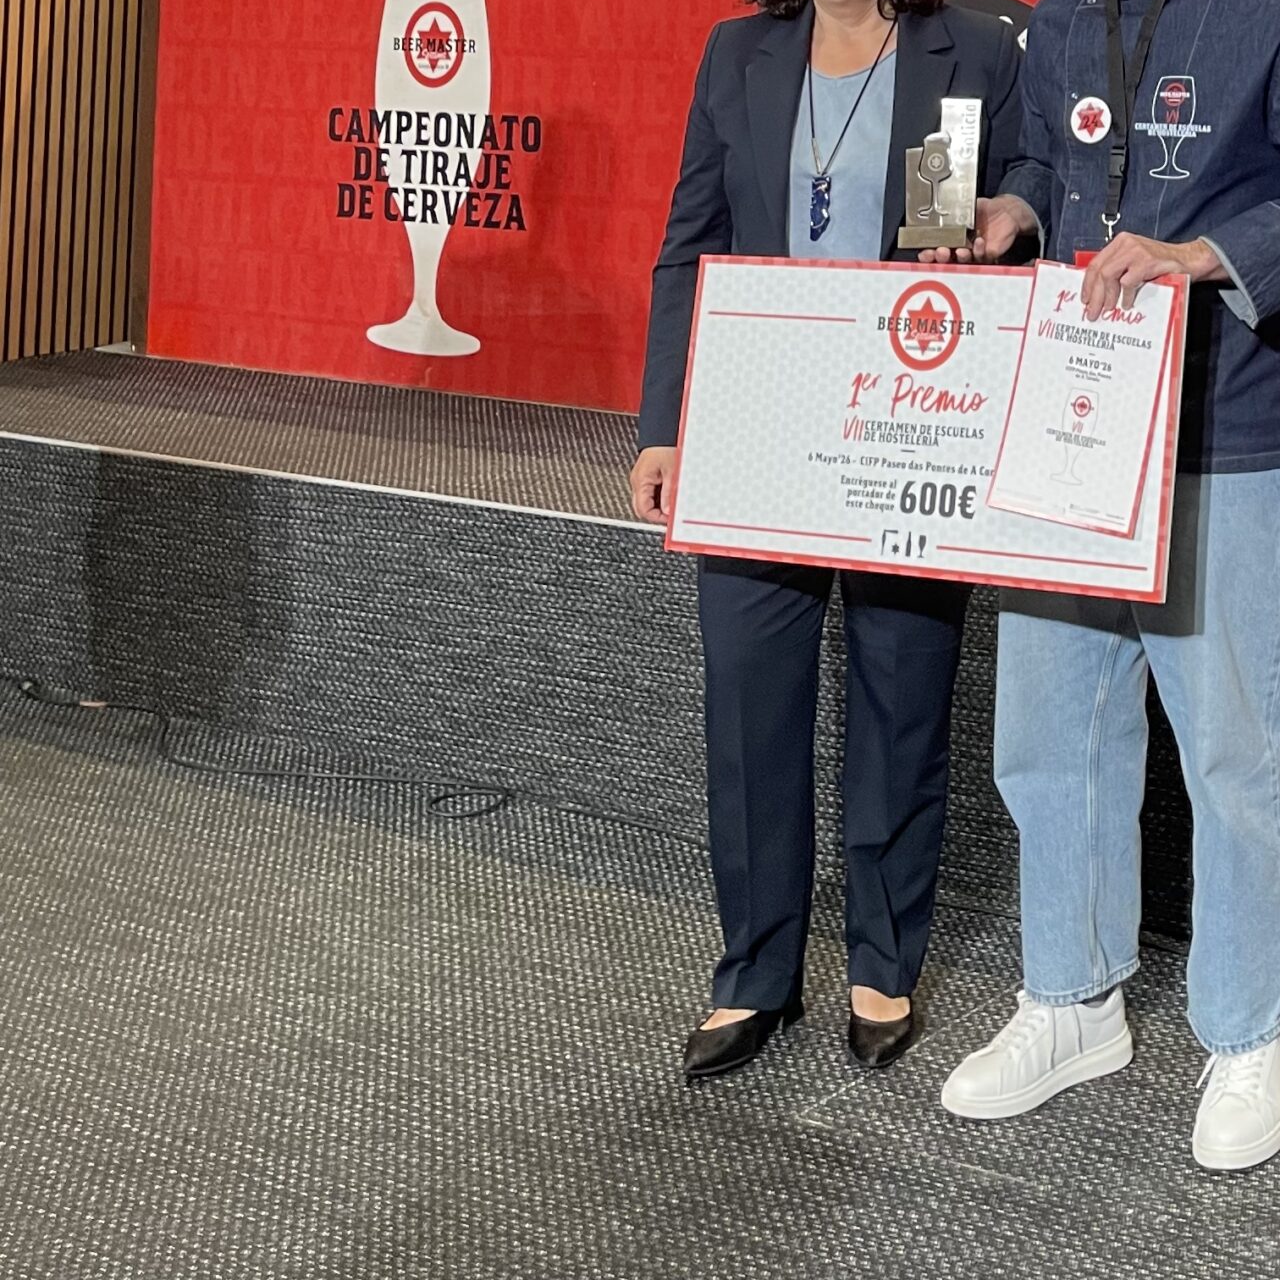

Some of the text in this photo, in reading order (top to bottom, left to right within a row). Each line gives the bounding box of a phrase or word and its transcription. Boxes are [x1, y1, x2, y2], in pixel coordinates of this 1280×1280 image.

[393, 37, 476, 53] BEER MASTER
[328, 107, 542, 153] CAMPEONATO
[353, 147, 512, 191] DE TIRAJE
[337, 183, 527, 233] DE CERVEZA
[877, 315, 912, 332] BEER
[916, 318, 976, 336] MASTER
[1038, 318, 1056, 340] VII
[1056, 323, 1153, 350] CERTAMEN DE ESCUELAS
[1069, 355, 1074, 365] 6
[847, 372, 989, 418] 1er Premio
[843, 415, 865, 442] VII
[863, 431, 876, 442] DE
[864, 420, 985, 440] CERTAMEN DE ESCUELAS
[808, 452, 813, 462] 6
[860, 456, 880, 468] CIFP
[881, 457, 906, 470] Paseo
[908, 460, 923, 471] das
[925, 461, 955, 474] Pontes
[957, 464, 969, 476] de
[970, 465, 978, 476] A
[840, 474, 897, 489] Entréguese al
[847, 488, 896, 501] portador de
[900, 480, 977, 520] 600€
[845, 499, 895, 513] este cheque
